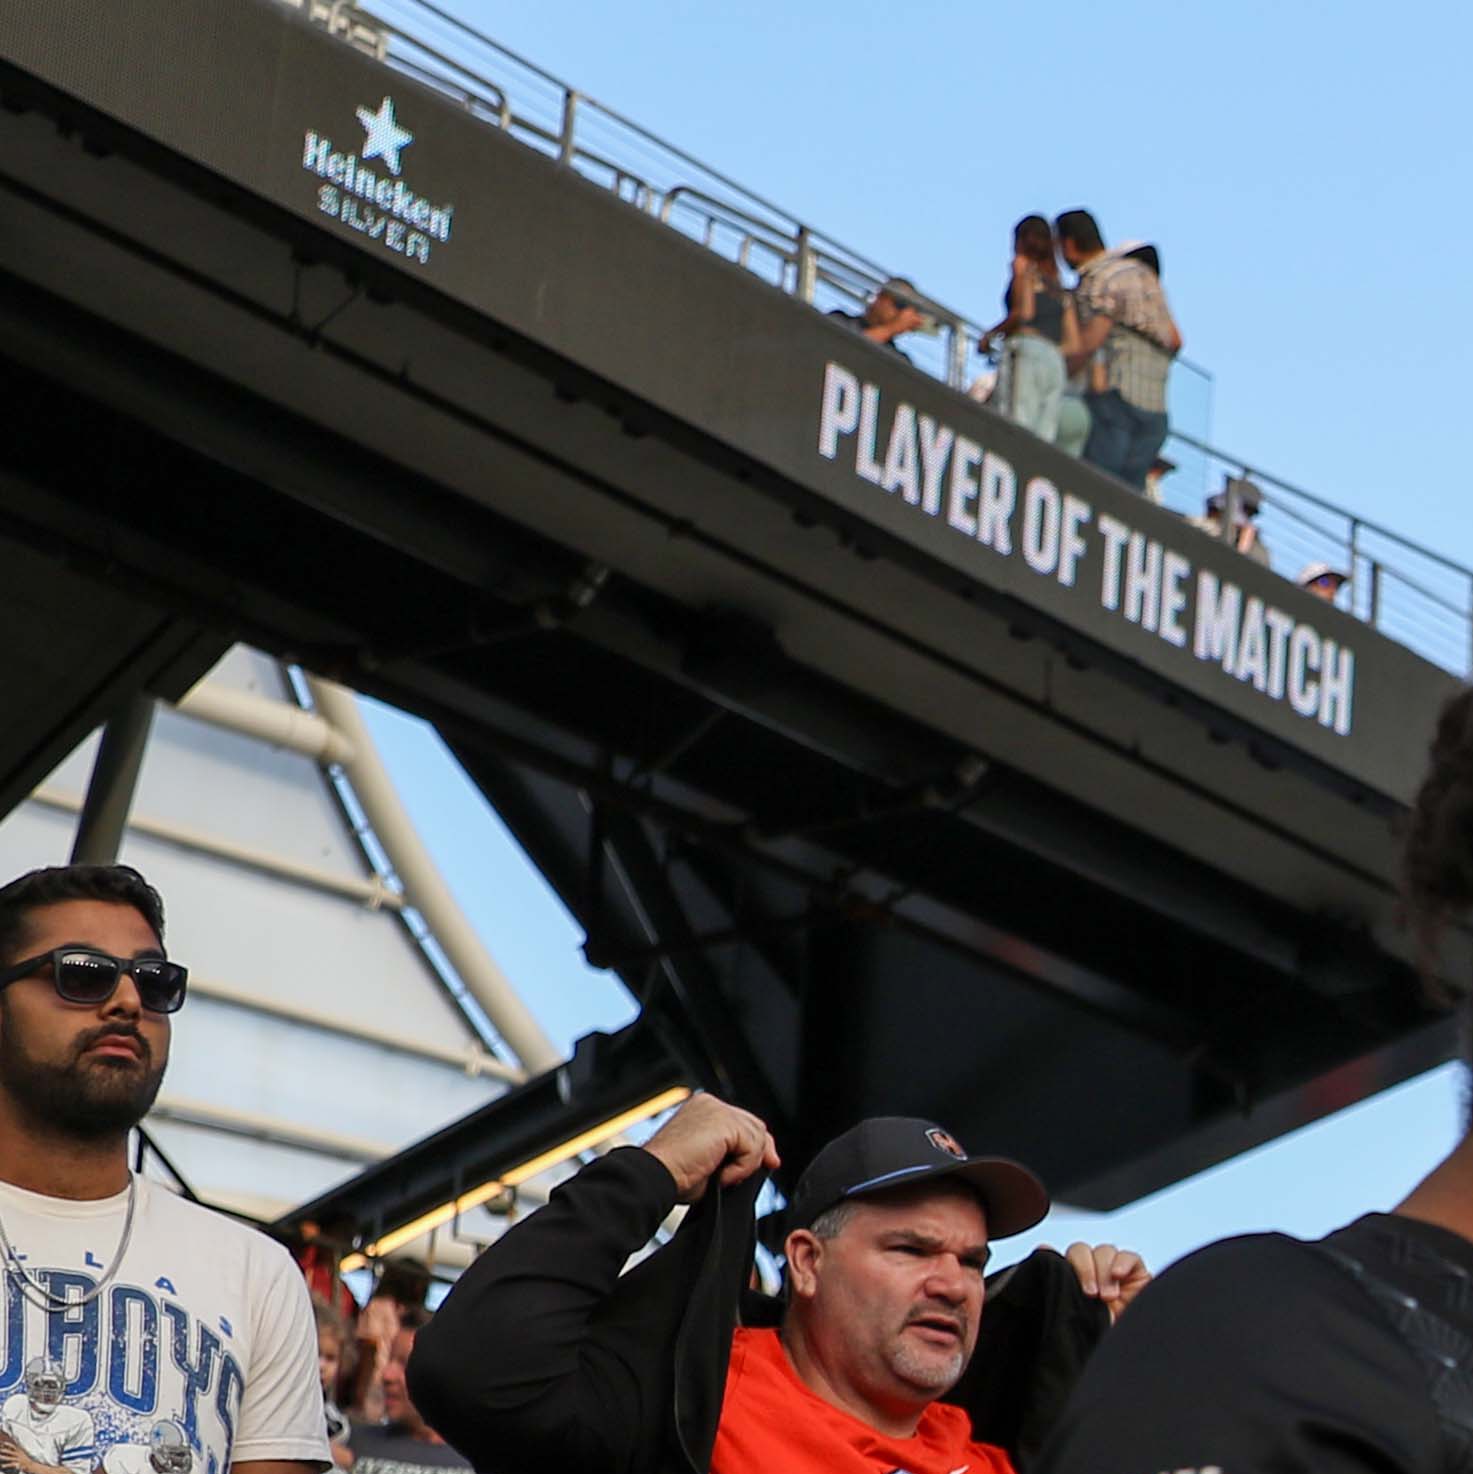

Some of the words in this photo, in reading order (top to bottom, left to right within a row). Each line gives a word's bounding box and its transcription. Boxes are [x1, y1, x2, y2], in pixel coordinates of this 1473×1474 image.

[303, 128, 454, 243] Heineken
[317, 183, 431, 265] SILVER
[819, 360, 1017, 557] PLAYER
[1023, 476, 1091, 587] OF
[1098, 512, 1191, 649] THE
[1193, 568, 1355, 737] MATCH
